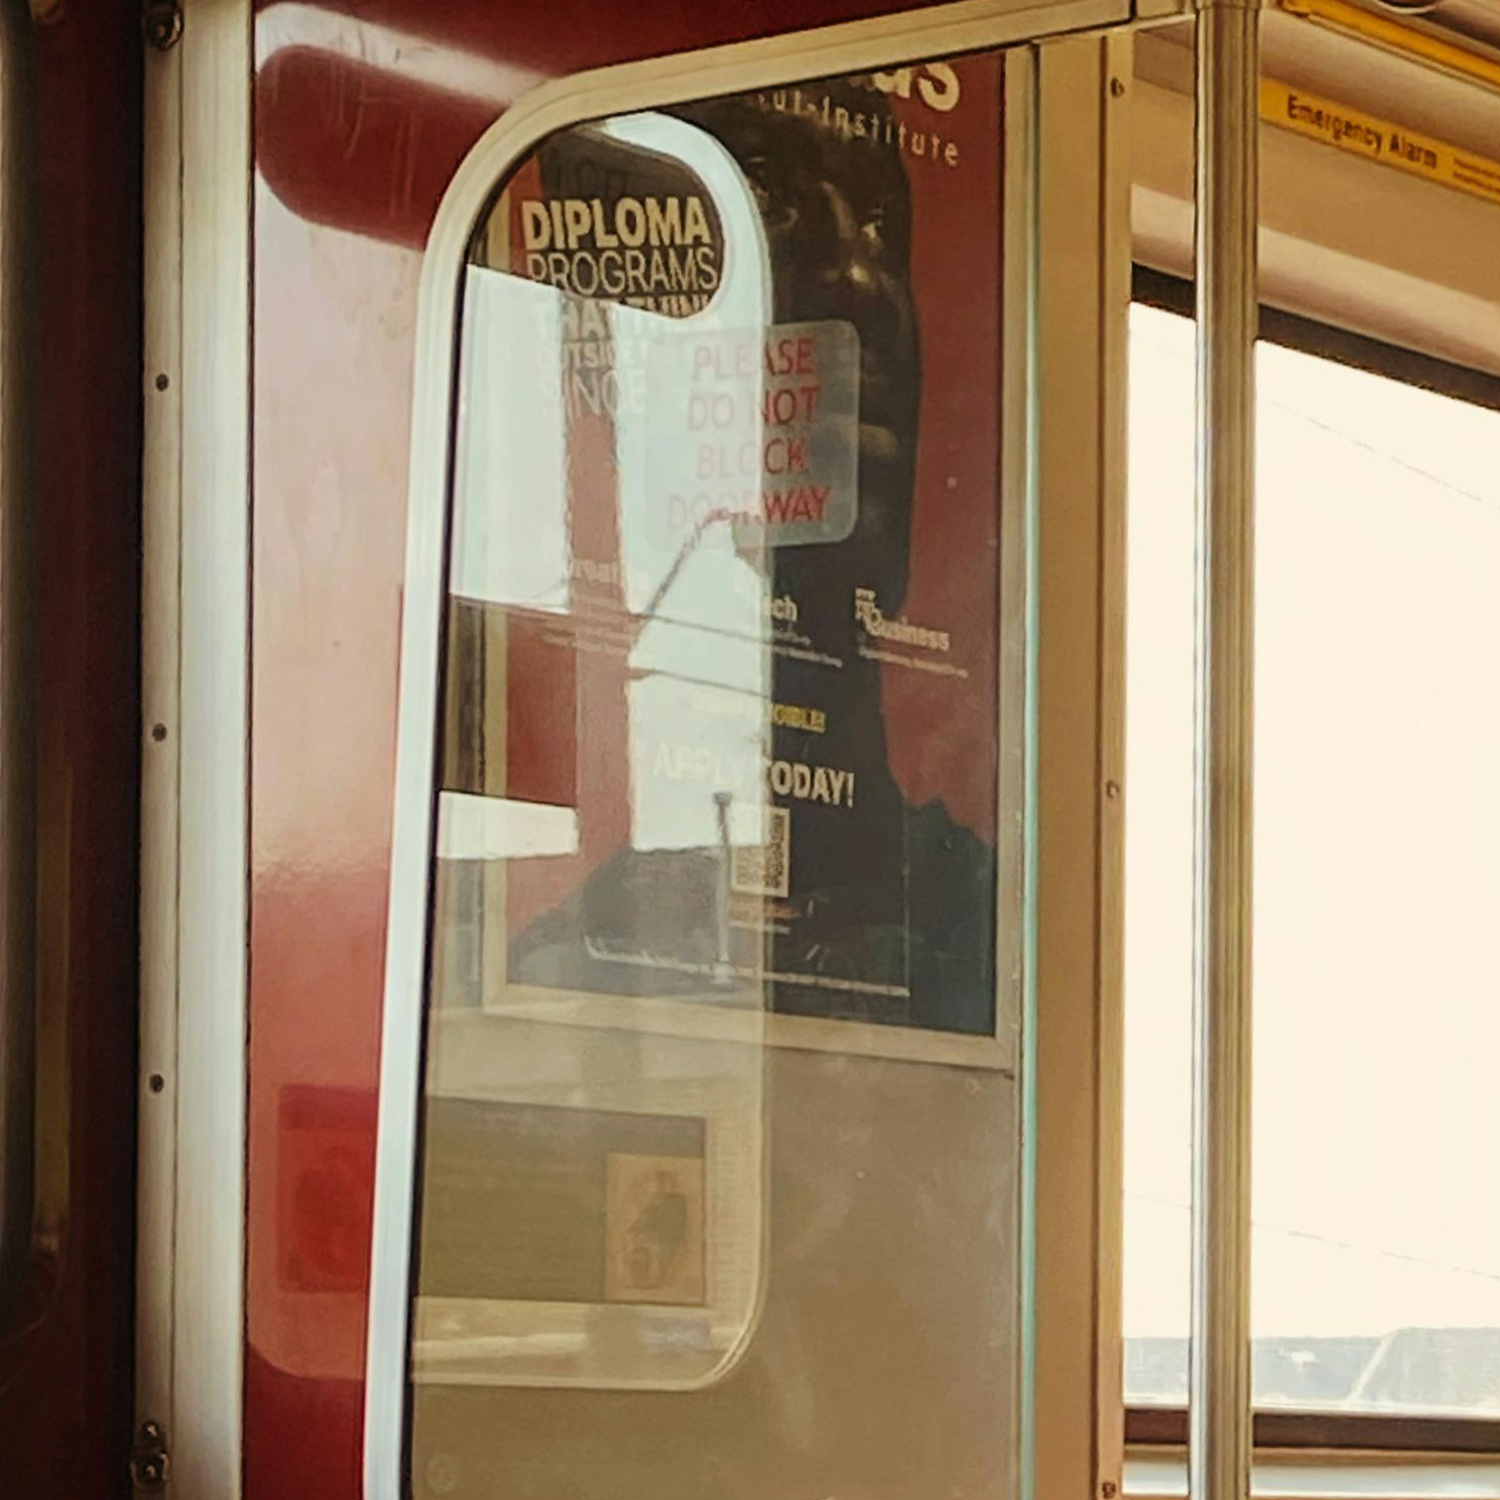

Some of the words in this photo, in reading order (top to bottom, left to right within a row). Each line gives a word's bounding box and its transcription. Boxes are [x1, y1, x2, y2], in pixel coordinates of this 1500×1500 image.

[1286, 92, 1384, 156] Emergency
[1389, 133, 1438, 169] Alarm
[521, 196, 713, 251] DIPLOMA
[525, 246, 719, 297] PROGRAMS
[688, 390, 735, 433] DO
[695, 436, 808, 481] BLOCK
